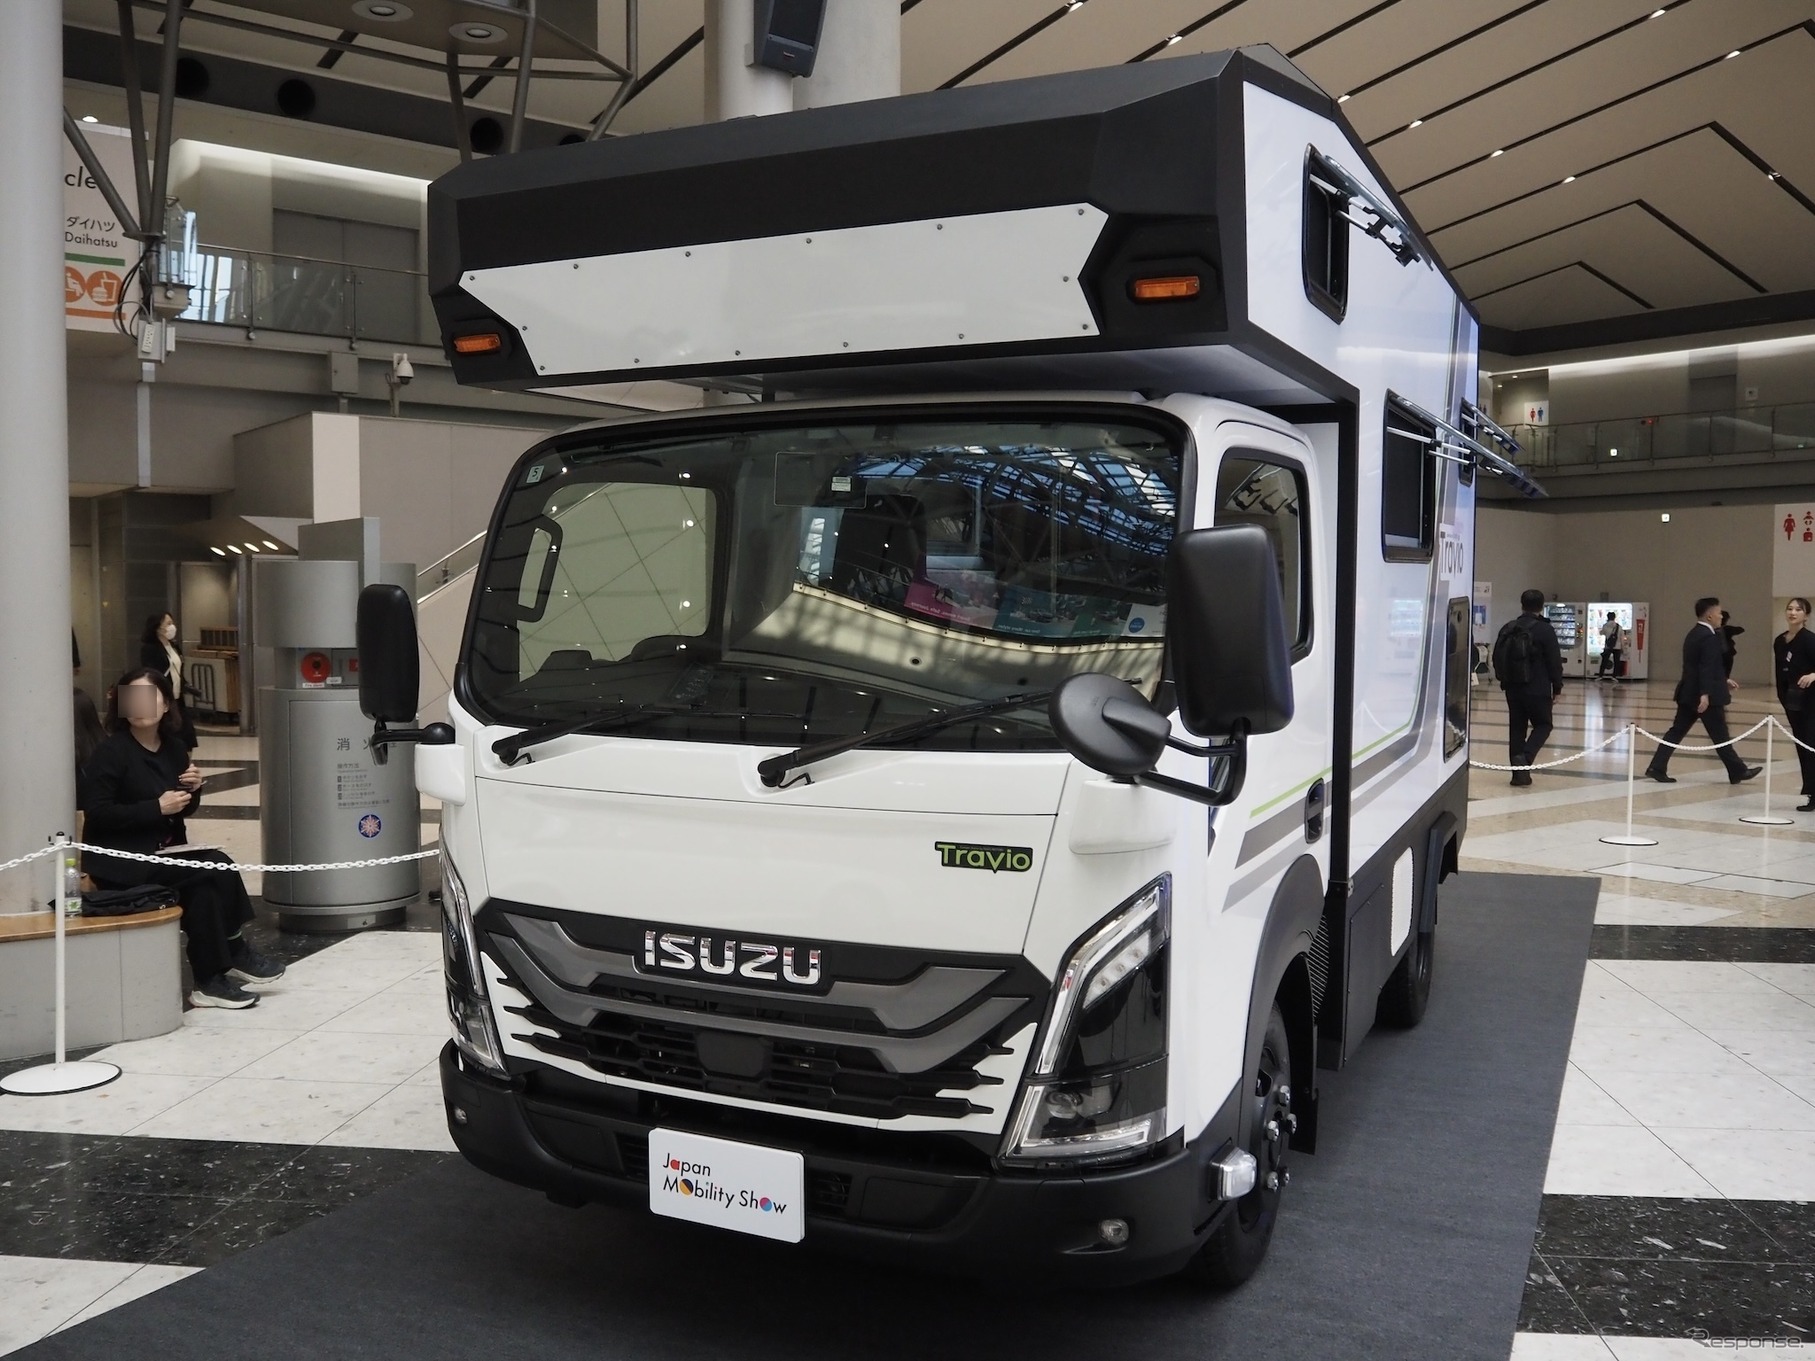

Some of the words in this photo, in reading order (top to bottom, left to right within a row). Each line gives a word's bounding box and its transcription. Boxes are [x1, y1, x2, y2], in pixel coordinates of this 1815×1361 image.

[66, 215, 116, 232] ダイハツ
[65, 231, 118, 248] Daihatsu
[937, 844, 1030, 871] Travio
[643, 930, 822, 985] ISUZU
[662, 1152, 711, 1178] Japan
[662, 1175, 734, 1209] Mobility
[738, 1190, 787, 1215] Show
